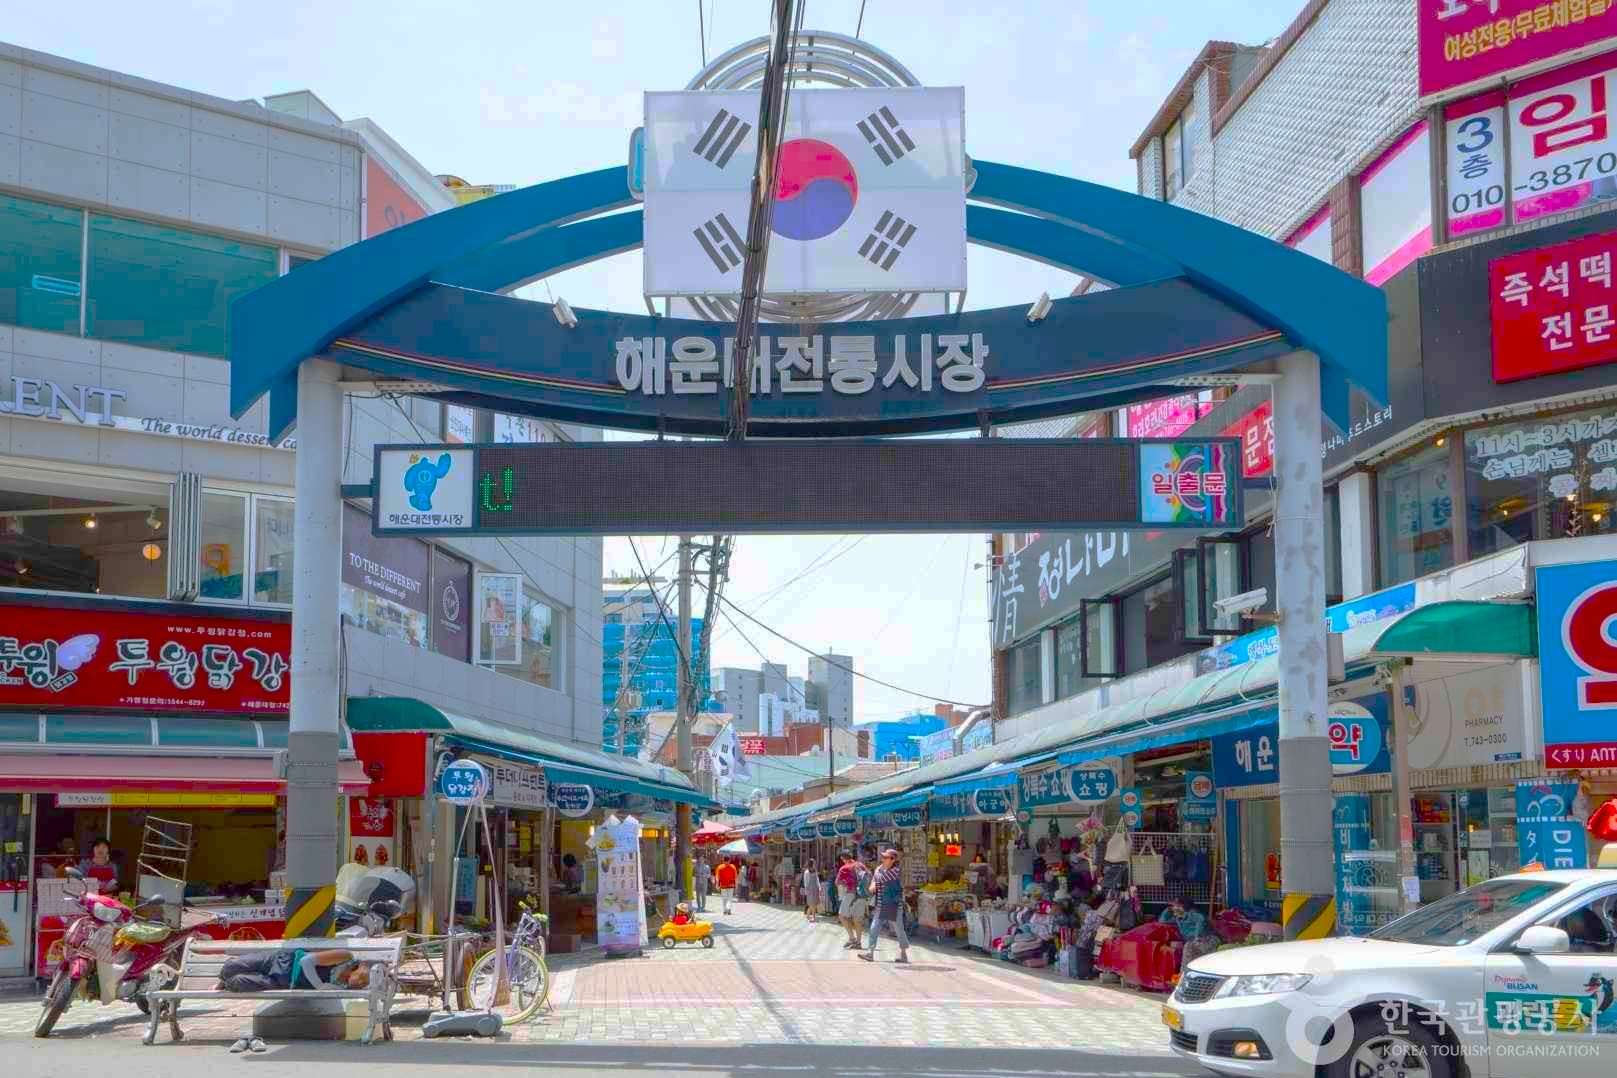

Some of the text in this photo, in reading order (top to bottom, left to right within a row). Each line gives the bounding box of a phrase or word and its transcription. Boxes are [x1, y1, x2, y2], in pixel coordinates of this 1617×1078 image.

[1452, 184, 1504, 214] 010
[141, 417, 171, 434] The
[176, 423, 223, 441] world
[388, 513, 464, 526] 해운대전통시장
[349, 552, 422, 595] TO THE DIFFERENT
[110, 638, 291, 692] 투윙닭강
[1464, 714, 1504, 728] PHARMACY
[1328, 722, 1363, 761] 약
[1551, 748, 1585, 763] くすり
[1079, 782, 1109, 796] 쇼핑
[1506, 983, 1538, 991] BUSAN
